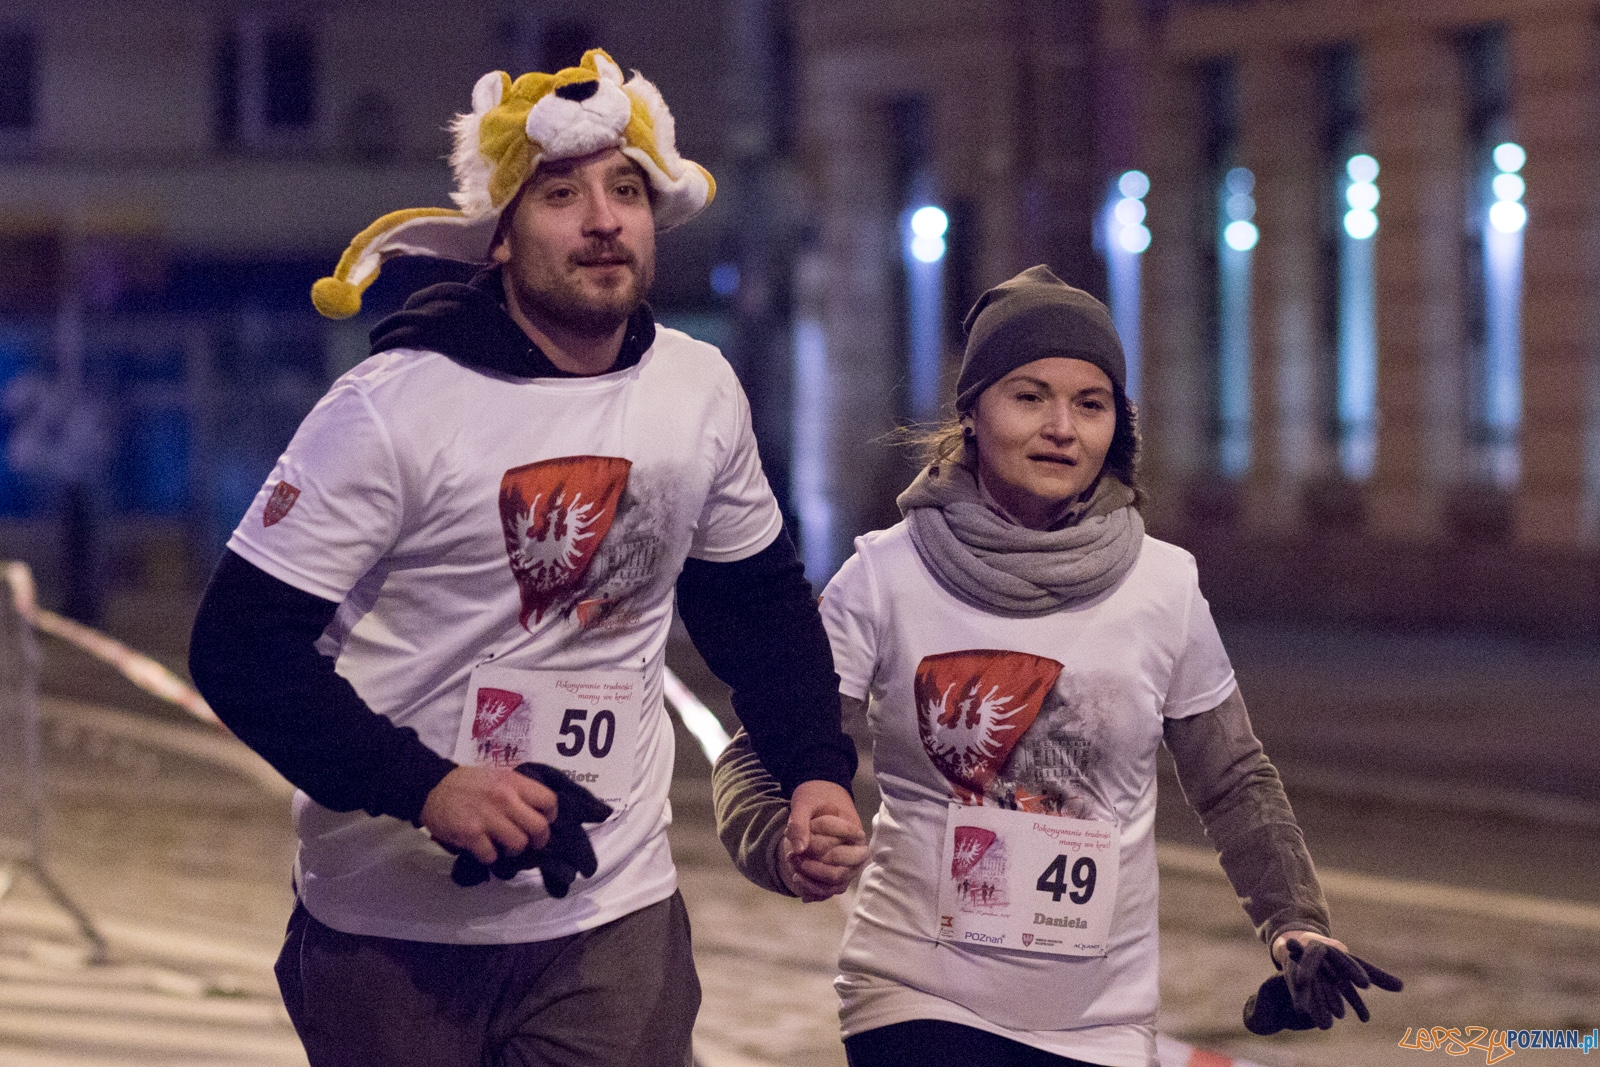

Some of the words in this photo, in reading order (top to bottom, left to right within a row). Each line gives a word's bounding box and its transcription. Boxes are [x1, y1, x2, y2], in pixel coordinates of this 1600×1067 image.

[555, 680, 600, 693] Pokonywanie
[578, 694, 600, 705] mamy
[556, 709, 616, 759] 50
[1032, 822, 1082, 839] Pokonywanie
[1059, 840, 1081, 852] mamy
[1036, 854, 1097, 905] 49
[1033, 912, 1088, 930] Daniela
